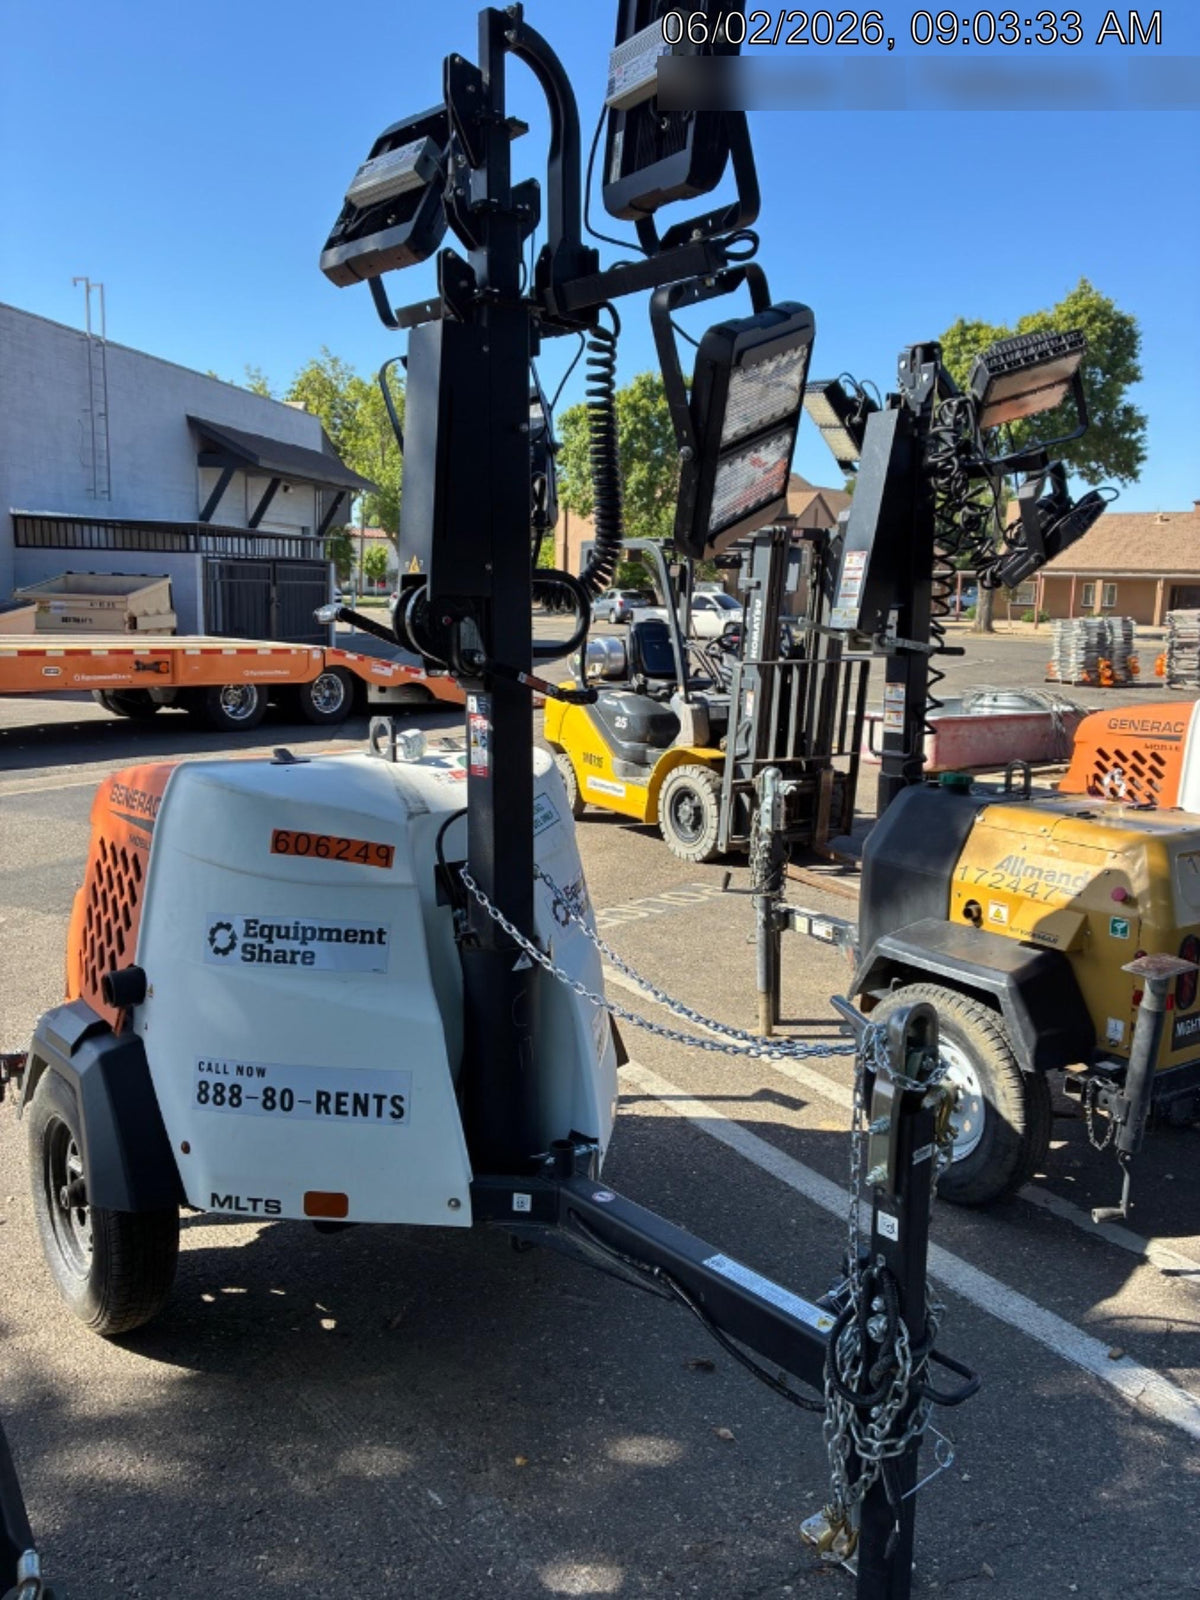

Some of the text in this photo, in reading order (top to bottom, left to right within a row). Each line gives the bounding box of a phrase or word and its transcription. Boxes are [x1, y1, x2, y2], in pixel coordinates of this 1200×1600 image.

[614, 715, 629, 730] 25
[1107, 717, 1186, 734] GENERAC
[274, 829, 391, 867] 606249
[949, 864, 1061, 901] 172447
[993, 854, 1091, 890] Allmand
[242, 918, 388, 946] Equipment
[240, 942, 316, 967] Share
[197, 1060, 268, 1079] CALL NOW
[196, 1079, 406, 1120] 888-80-RENTS
[209, 1191, 283, 1215] MLTS
